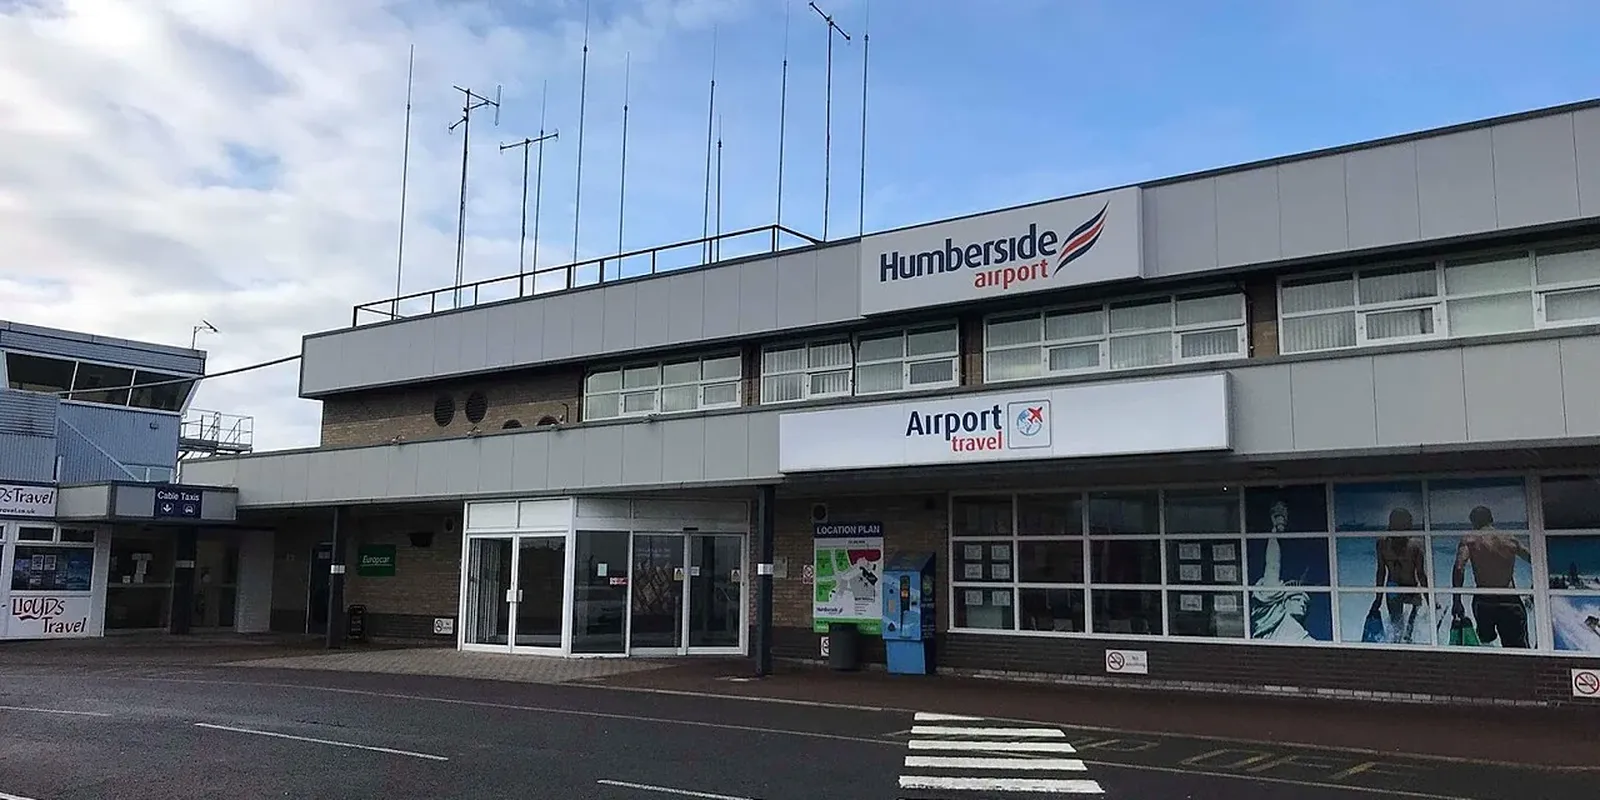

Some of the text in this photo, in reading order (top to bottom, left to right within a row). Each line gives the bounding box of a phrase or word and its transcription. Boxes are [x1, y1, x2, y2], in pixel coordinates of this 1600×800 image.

[879, 223, 1059, 283] Humberside
[974, 258, 1049, 290] airport
[905, 404, 1002, 441] Airport
[951, 431, 1002, 452] travel
[13, 487, 54, 504] Travel
[180, 492, 200, 501] Taxis
[816, 525, 880, 535] LOCATION PLAN
[362, 554, 390, 565] Europcar
[41, 616, 87, 633] Travel
